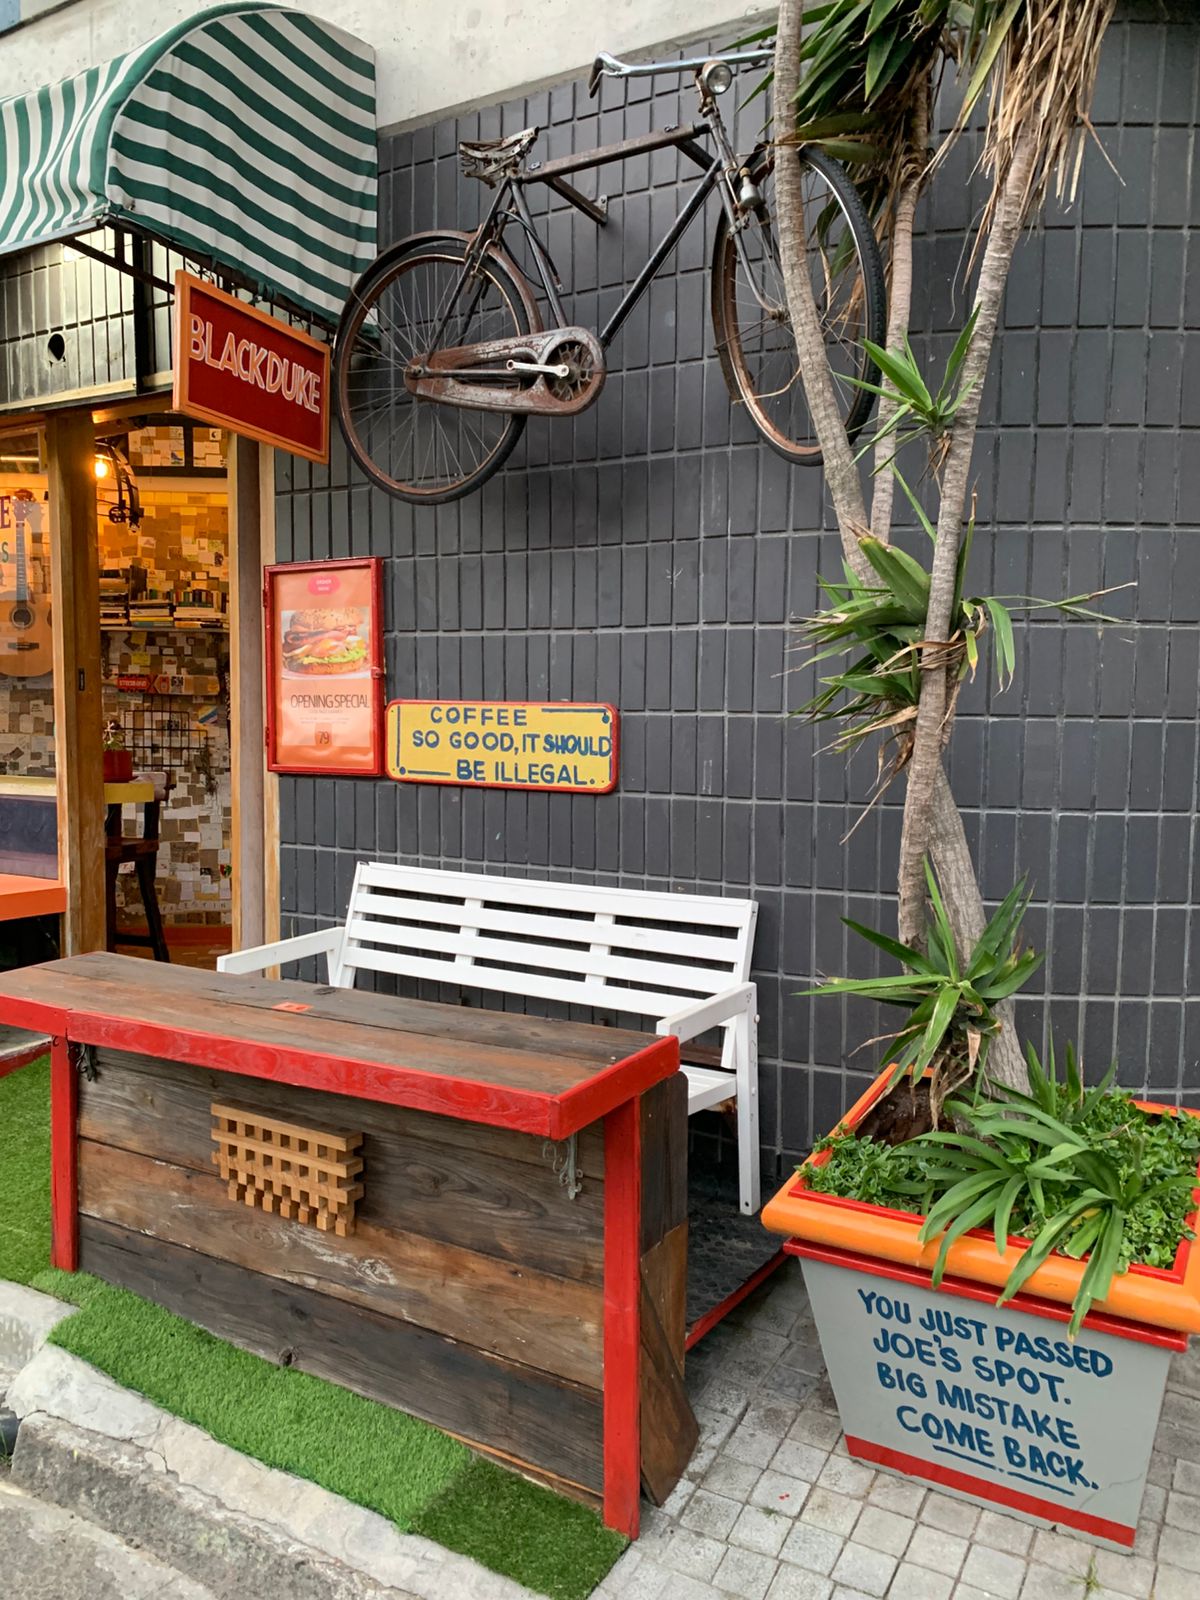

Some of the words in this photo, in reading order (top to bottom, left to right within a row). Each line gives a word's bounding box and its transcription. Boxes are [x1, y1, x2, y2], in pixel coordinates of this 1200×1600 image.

[189, 313, 321, 414] BLACKDUKE
[290, 694, 334, 708] OPENING
[334, 694, 369, 708] SPECIAL
[430, 706, 527, 726] COFFEE
[412, 730, 440, 748] SO
[522, 734, 541, 753] IT
[542, 734, 612, 757] SHOULD
[456, 759, 486, 781] BE
[857, 1289, 911, 1324] YOU
[919, 1308, 987, 1346] JUST
[994, 1326, 1113, 1377] PASSED
[873, 1328, 962, 1373] JOE'S
[972, 1356, 1072, 1405] SPOT.
[876, 1361, 927, 1399] BIG
[936, 1379, 1081, 1450] MISTAKE
[896, 1405, 995, 1458] COME
[1002, 1435, 1100, 1490] BACK.
